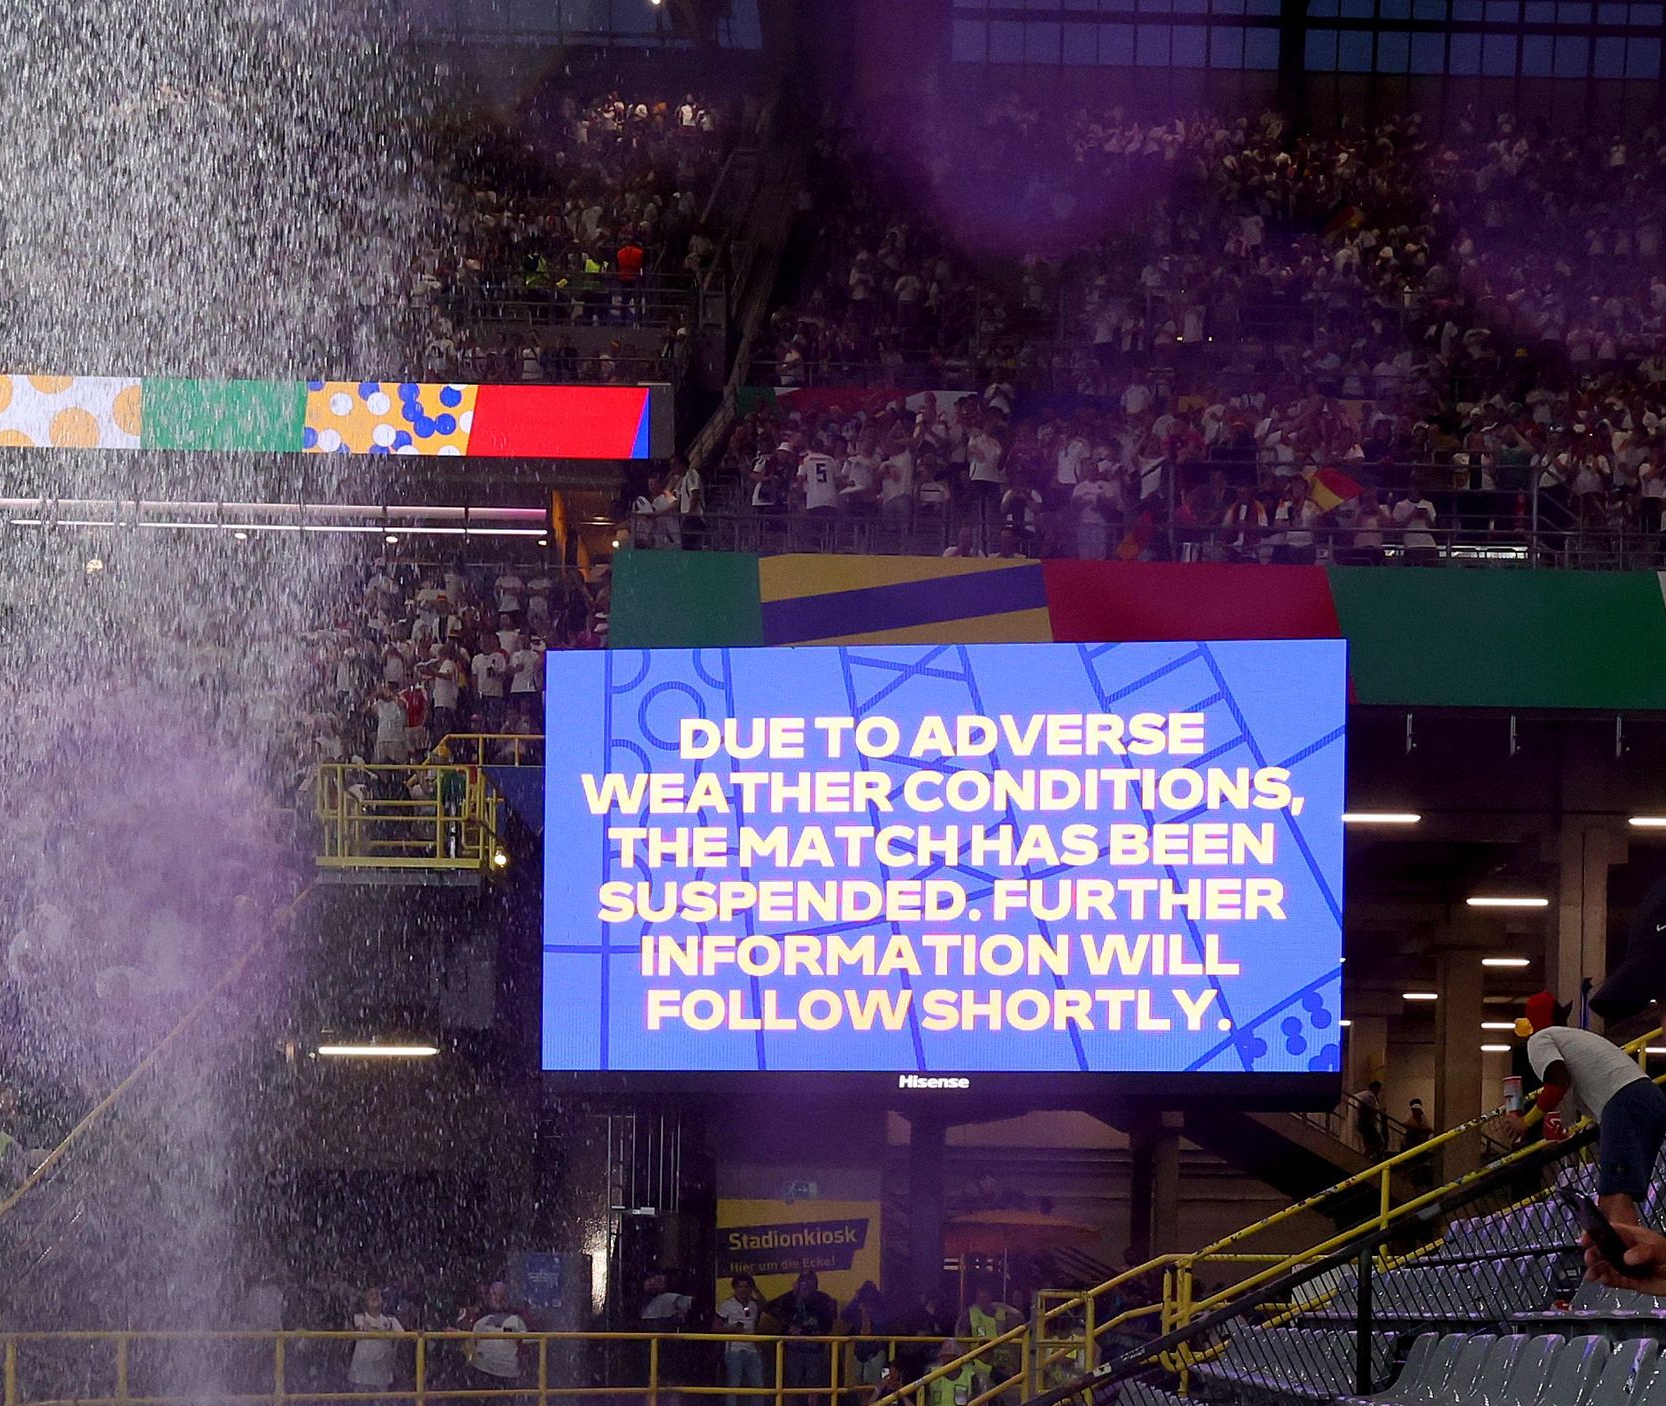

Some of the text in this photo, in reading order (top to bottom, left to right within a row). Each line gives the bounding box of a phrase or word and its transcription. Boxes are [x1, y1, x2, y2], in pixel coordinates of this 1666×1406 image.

[815, 462, 828, 483] 5
[679, 712, 1206, 760] DUE TO ADVERSE
[579, 766, 1307, 818] WEATHER CONDITIONS,
[606, 821, 1276, 870] THE MATCH HAS BEEN
[596, 877, 1288, 924] SUSPENDED. FURTHER
[640, 932, 1241, 978] INFORMATION WILL
[645, 987, 1233, 1033] FOLLOW SHORTLY.
[898, 1074, 971, 1089] Hisense
[727, 1225, 858, 1251] Stadionkiosk
